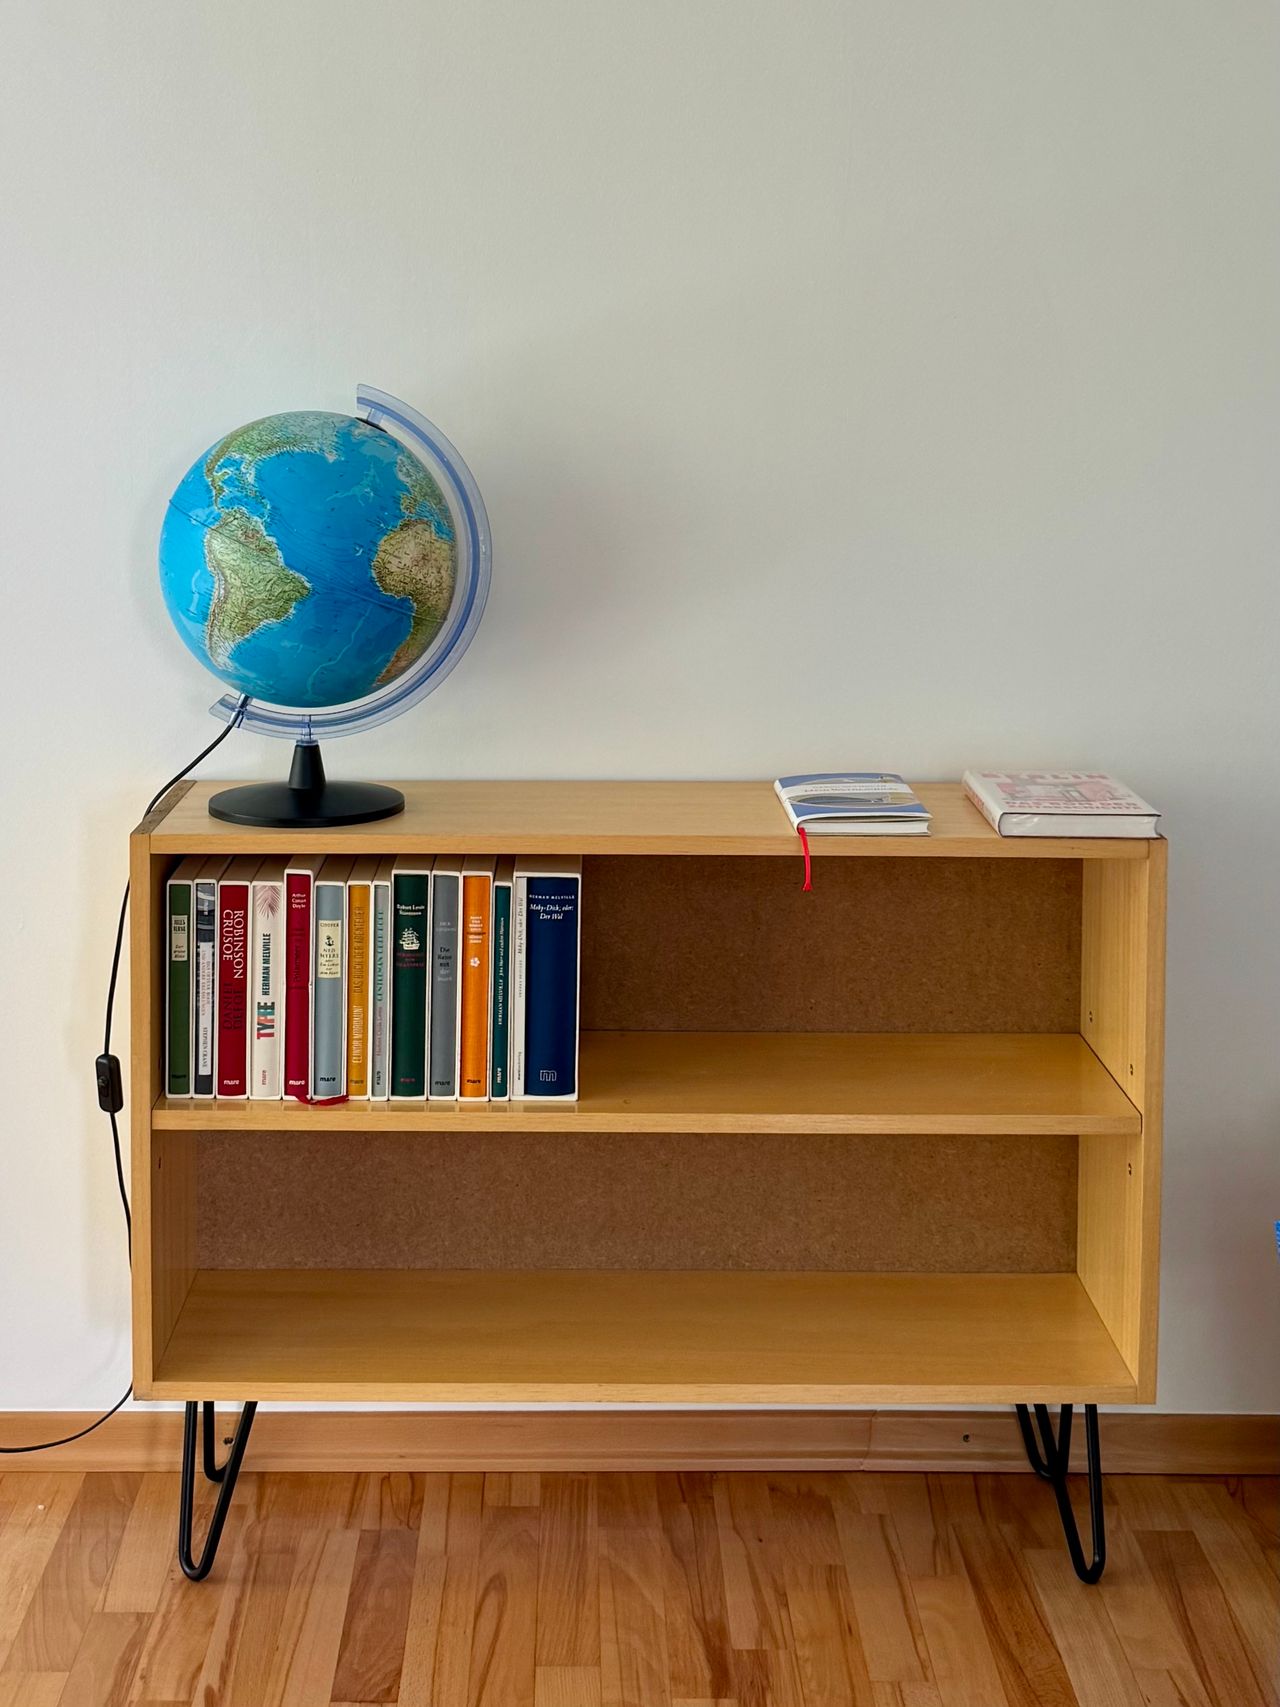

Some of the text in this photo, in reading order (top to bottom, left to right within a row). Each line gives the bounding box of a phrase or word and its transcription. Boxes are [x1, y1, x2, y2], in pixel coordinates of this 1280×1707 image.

[223, 909, 233, 960] CRUSOE
[233, 910, 244, 978] ROBINSON
[354, 945, 364, 959] DER
[262, 933, 271, 995] HERMAN MELVILLE
[354, 981, 364, 993] DAS
[257, 1002, 275, 1039] TYPEE
